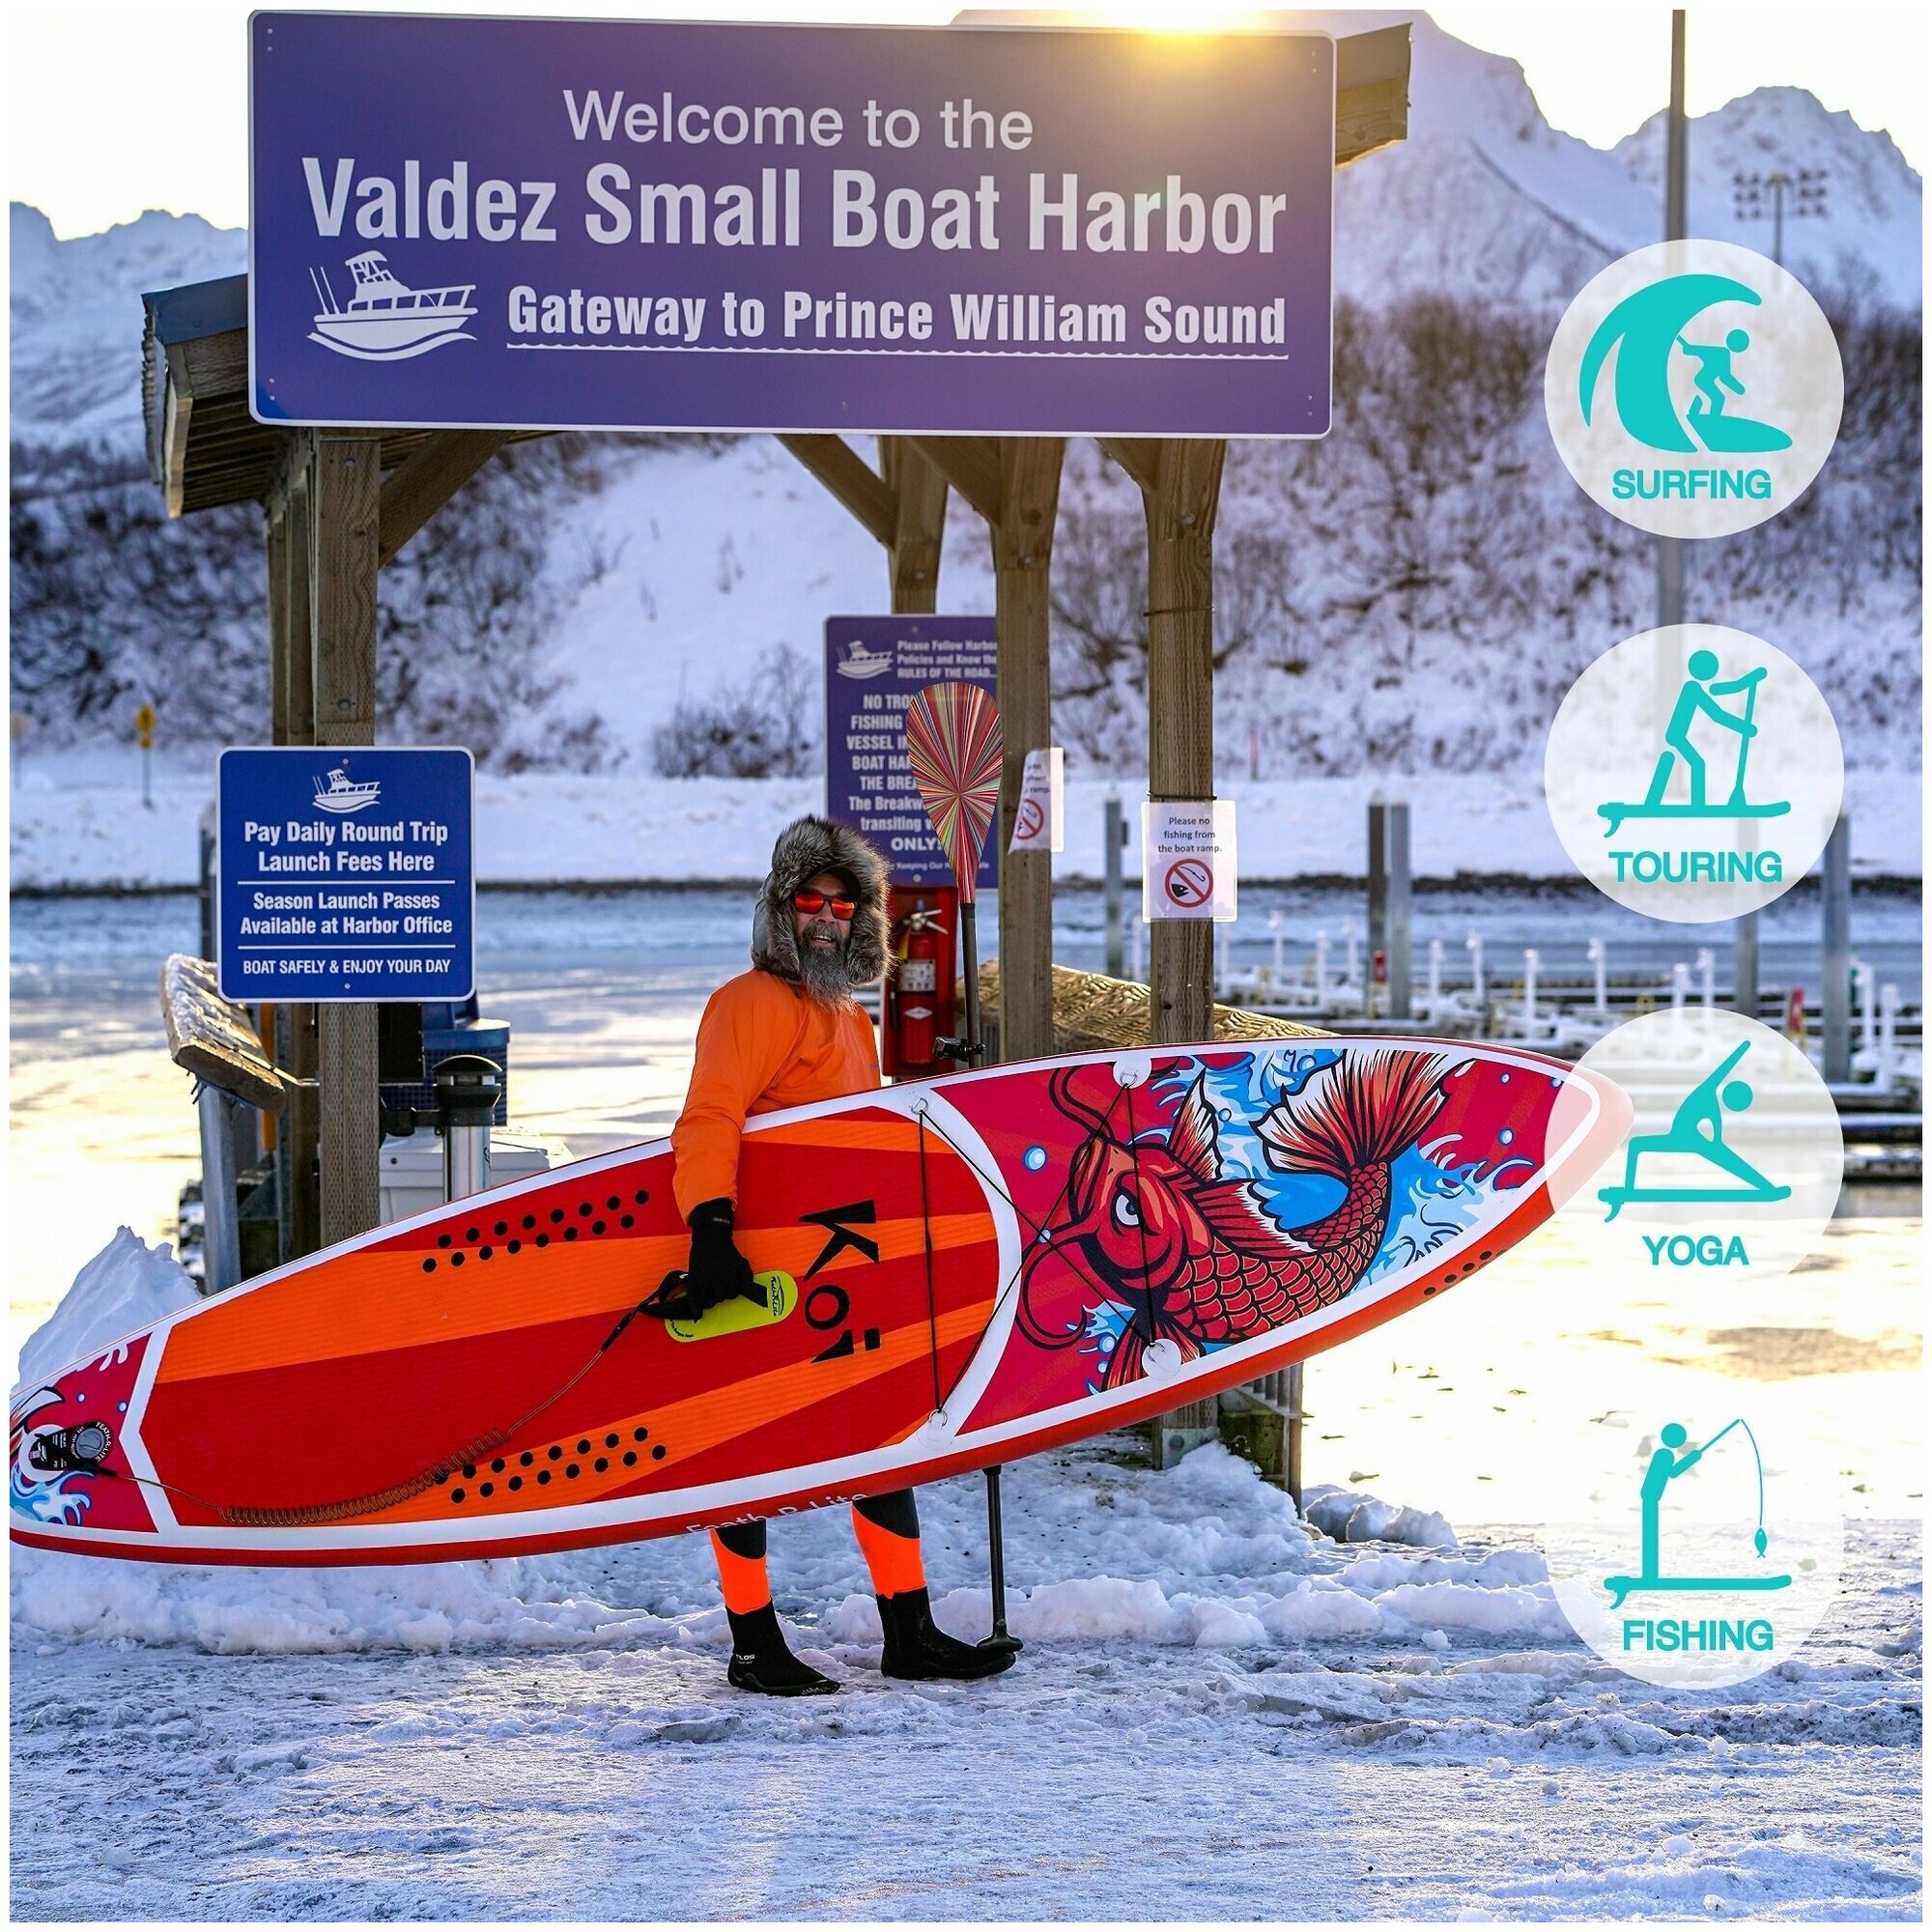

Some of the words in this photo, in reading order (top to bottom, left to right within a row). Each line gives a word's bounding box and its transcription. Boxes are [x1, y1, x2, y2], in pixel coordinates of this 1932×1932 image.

[562, 89, 844, 147] Welcome
[862, 99, 921, 149] to
[939, 98, 1034, 151] the
[301, 156, 557, 242] Valdez
[584, 162, 800, 246] Small
[833, 169, 1000, 250] Boat
[1029, 173, 1287, 254] Harbor
[506, 285, 707, 344] Gateway
[722, 292, 765, 337] to
[783, 291, 933, 340] Prince
[950, 294, 1126, 343] William
[1144, 296, 1286, 345] Sound
[896, 639, 929, 651] Please
[931, 639, 963, 651] Follow
[935, 654, 954, 665] and
[928, 667, 942, 678] OF
[944, 667, 962, 678] THE
[863, 694, 883, 710] NO
[885, 694, 913, 710] TRO
[850, 715, 903, 730] FISHING
[846, 735, 895, 751] VESSEL
[852, 754, 886, 771] BOAT
[860, 775, 884, 790] THE
[848, 795, 872, 810] The
[860, 816, 922, 833] transiting
[1168, 816, 1197, 826] Please
[244, 821, 281, 847] Pay
[287, 821, 336, 846] Daily
[341, 821, 405, 842] Round
[409, 820, 448, 846] Trip
[1163, 830, 1193, 840] fishing
[1194, 830, 1216, 838] from
[1157, 844, 1173, 853] the
[1174, 844, 1195, 853] boat
[1196, 845, 1223, 854] ramp.
[258, 851, 330, 872] Launch
[336, 850, 384, 872] Fees
[388, 850, 435, 871] Here
[253, 892, 313, 910] Season
[318, 892, 379, 910] Launch
[383, 892, 440, 909] Passes
[240, 917, 317, 934] Available
[321, 917, 339, 934] at
[343, 916, 400, 934] Harbor
[403, 916, 453, 934] Office
[242, 959, 277, 975] BOAT
[279, 959, 327, 975] SAFELY
[328, 959, 339, 974] &
[342, 959, 384, 974] ENJOY
[386, 959, 423, 974] YOUR
[425, 958, 451, 973] DAY
